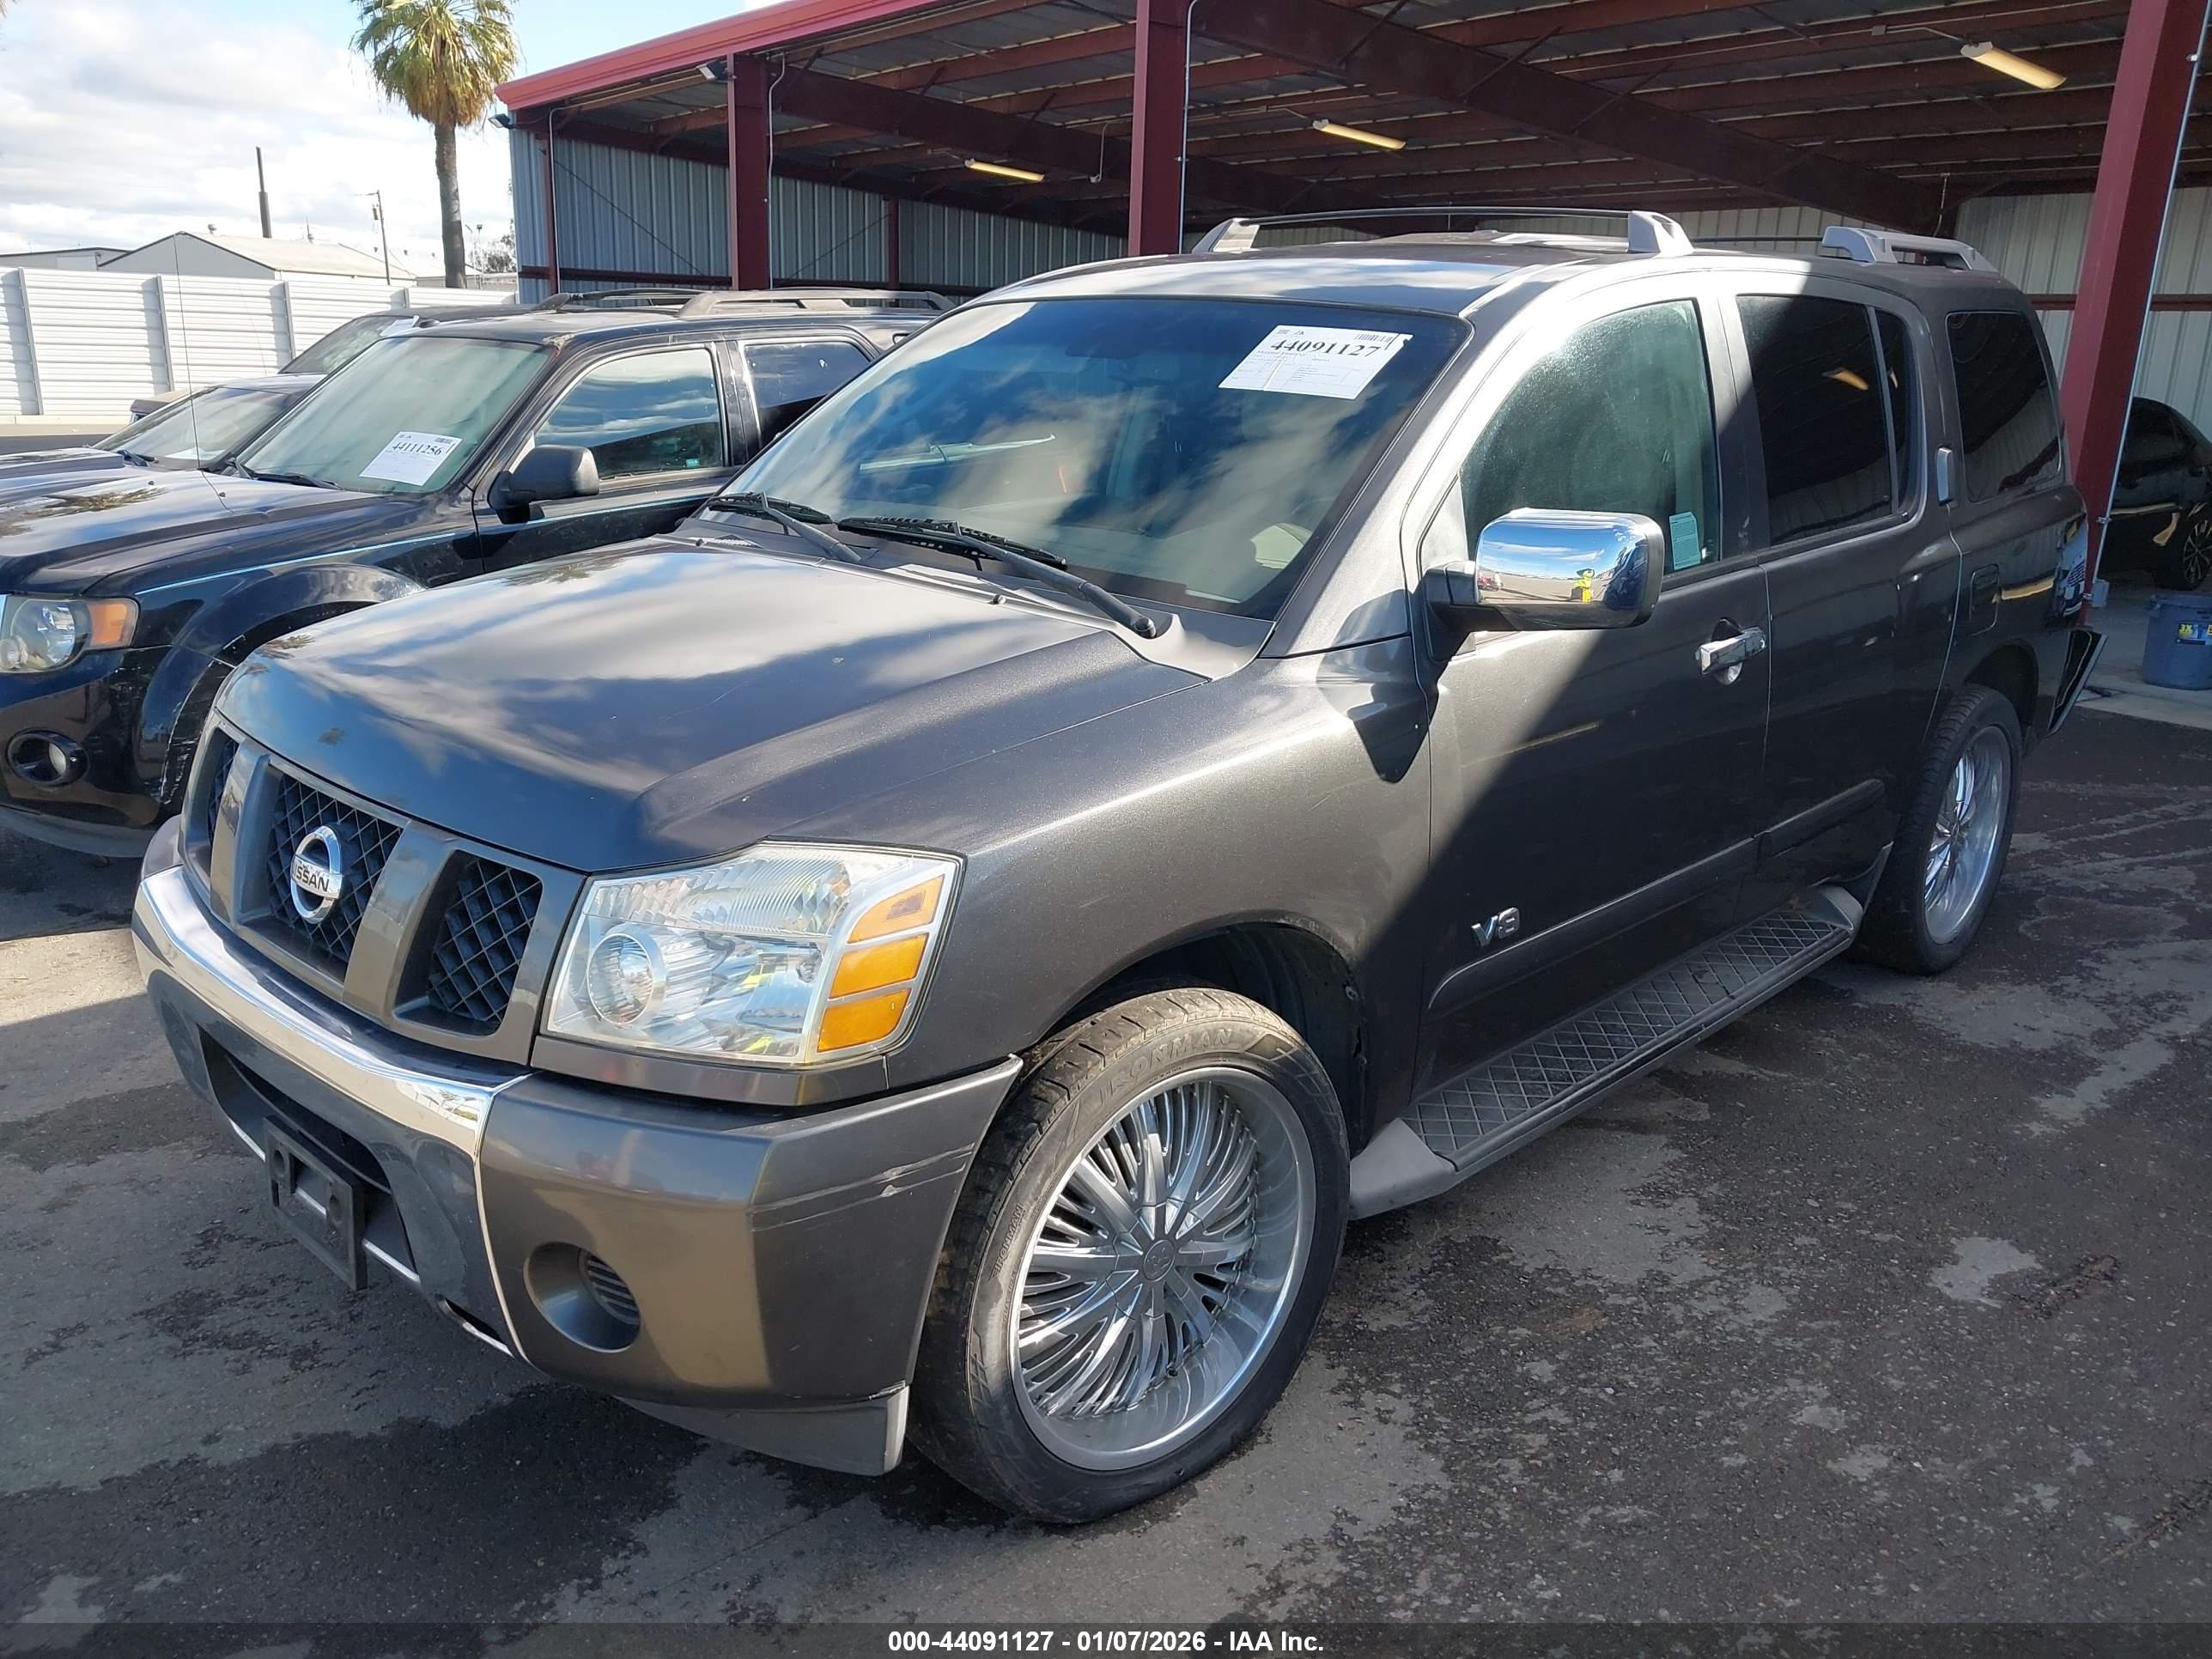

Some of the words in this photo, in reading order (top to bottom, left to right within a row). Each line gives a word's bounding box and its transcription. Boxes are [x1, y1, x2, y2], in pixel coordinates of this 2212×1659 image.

[1270, 338, 1382, 358] 44091127
[392, 441, 445, 456] 44111256
[1100, 1029, 1233, 1105] IRONMAN
[994, 1203, 1026, 1276] IRONMAN
